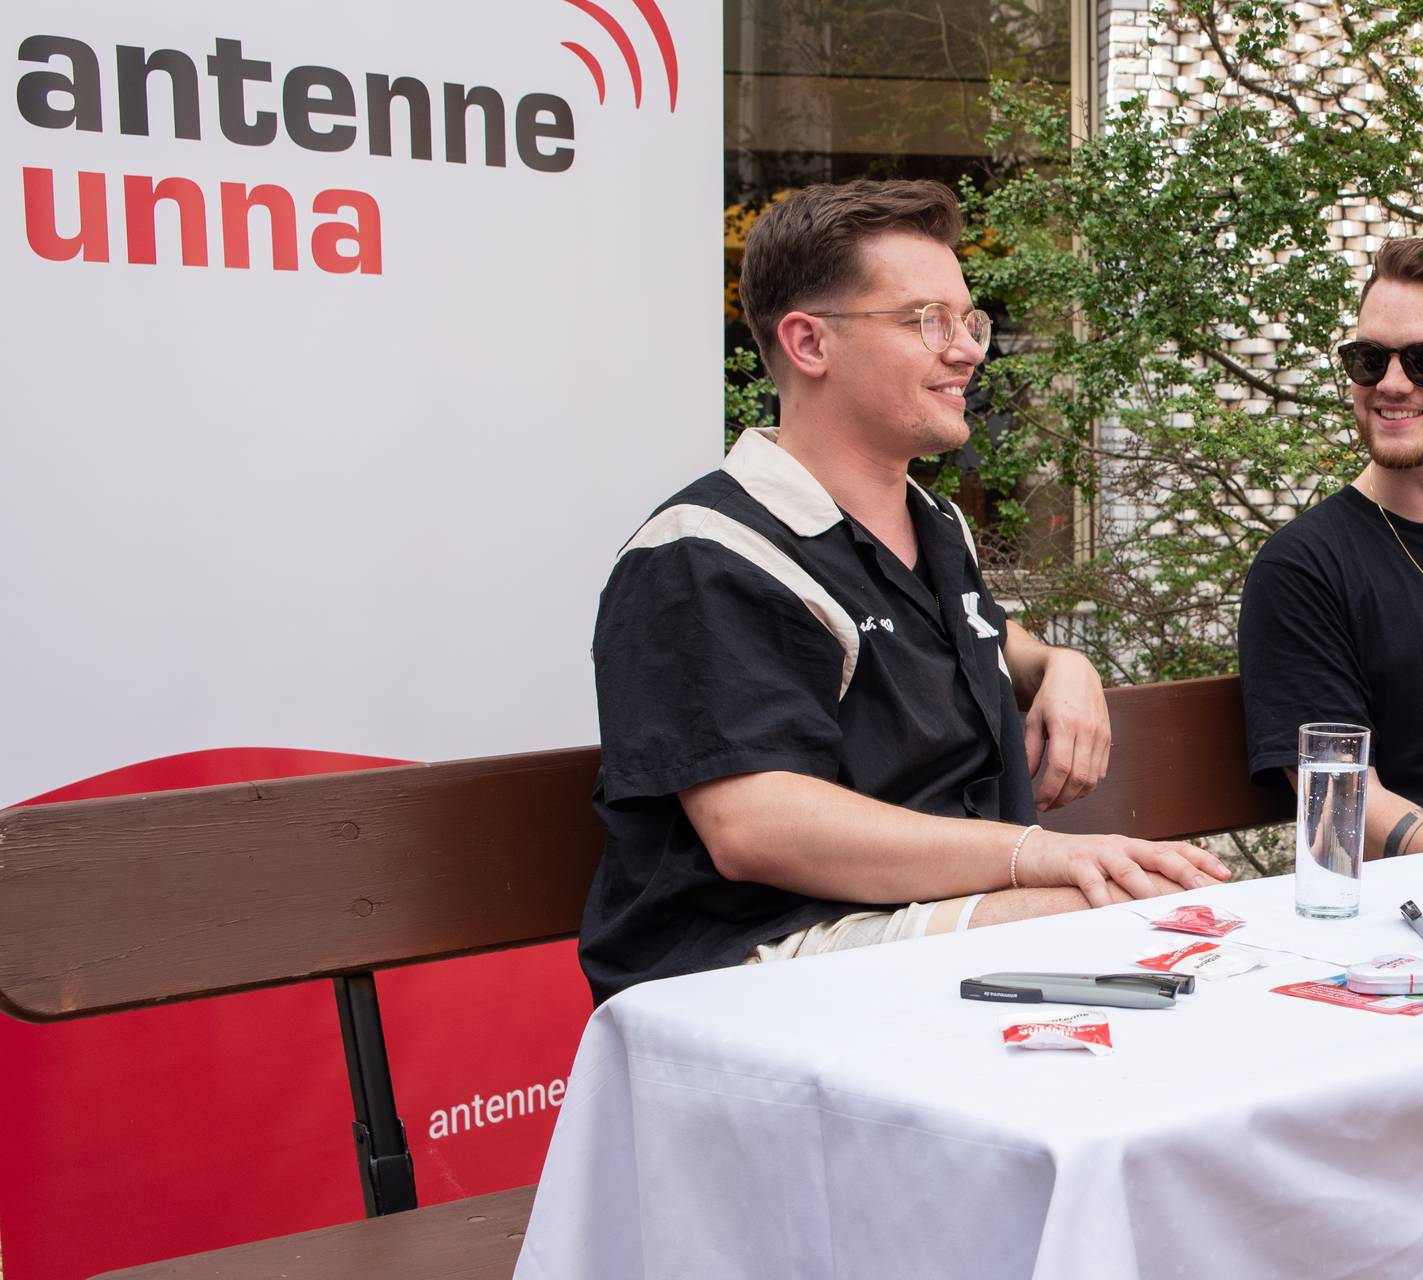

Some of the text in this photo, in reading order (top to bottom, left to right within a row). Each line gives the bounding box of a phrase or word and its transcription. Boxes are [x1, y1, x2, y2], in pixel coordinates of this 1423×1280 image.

[16, 34, 576, 173] antenne
[22, 166, 383, 275] unna
[428, 1076, 571, 1140] antenne
